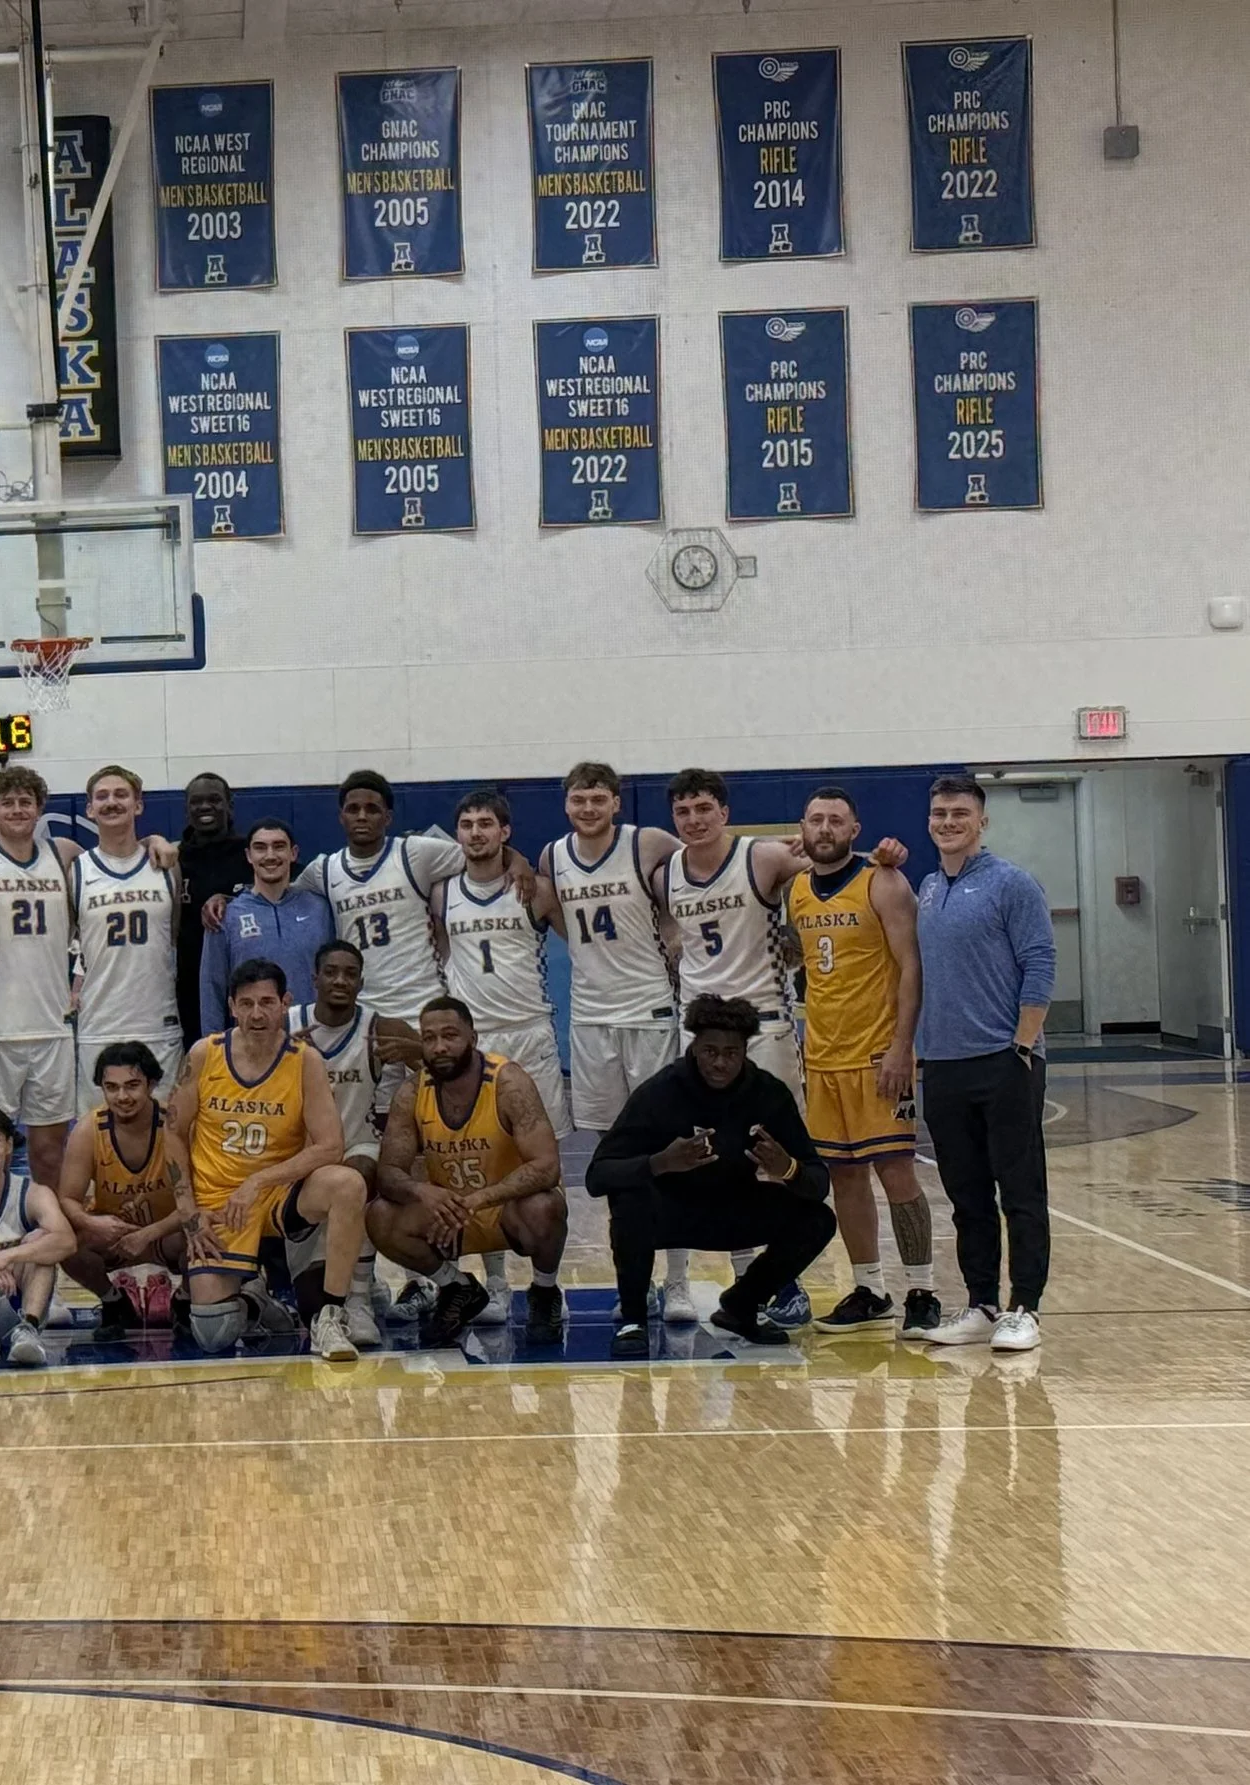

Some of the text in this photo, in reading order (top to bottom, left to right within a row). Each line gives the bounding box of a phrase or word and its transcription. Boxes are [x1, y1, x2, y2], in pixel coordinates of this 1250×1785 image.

[572, 101, 606, 120] GNAC
[764, 101, 791, 119] PRC
[954, 90, 981, 110] PRC
[381, 120, 418, 140] GNAC
[546, 120, 636, 142] TOURNAMENT
[738, 120, 819, 142] CHAMPIONS
[928, 110, 1010, 133] CHAMPIONS
[174, 132, 251, 154] NCAA WEST
[360, 141, 440, 162] CHAMPIONS
[554, 144, 629, 164] CHAMPIONS
[950, 136, 987, 166] RIFLE
[181, 155, 246, 175] REGIONAL
[760, 146, 798, 174] RIFLE
[347, 168, 455, 194] MEN'S BASKETBALL
[538, 171, 646, 198] MEN'S BASKETBALL
[941, 170, 998, 200] 2022
[160, 182, 267, 208] MEN'S BASKETBALL
[754, 180, 805, 210] 2014
[374, 198, 429, 227] 2005
[565, 200, 620, 230] 2022
[188, 212, 242, 241] 2003
[54, 130, 101, 441] ALASKA
[578, 356, 616, 375] NCAA
[770, 360, 798, 380] PRC
[960, 352, 988, 370] PRC
[201, 372, 237, 390] NCAA
[390, 366, 428, 384] NCAA
[546, 376, 651, 398] WEST REGIONAL
[934, 370, 1016, 394] CHAMPIONS
[168, 392, 272, 414] WEST REGIONAL
[358, 386, 462, 408] WEST REGIONAL
[744, 380, 826, 403] CHAMPIONS
[380, 407, 441, 428] SWEET 16
[568, 398, 630, 418] SWEET 16
[766, 406, 804, 433] RIFLE
[956, 396, 994, 425] RIFLE
[190, 414, 250, 434] SWEET 16
[358, 435, 464, 462] MEN'S BASKETBALL
[544, 424, 654, 452] MEN'S BASKETBALL
[947, 430, 1004, 460] 2025
[168, 441, 274, 468] MEN'S BASKETBALL
[760, 438, 813, 469] 2015
[384, 464, 440, 494] 2005
[572, 454, 628, 484] 2022
[194, 470, 248, 500] 2004
[88, 889, 164, 910] ALASKA
[336, 888, 406, 914] ALASKA
[560, 881, 630, 903] ALASKA
[12, 900, 48, 936] 21
[675, 894, 746, 919] ALASKA
[106, 910, 148, 947] 20
[354, 912, 391, 950] 13
[450, 917, 524, 936] ALASKA
[576, 905, 618, 944] 14
[800, 912, 860, 930] ALASKA
[700, 920, 724, 957] 5
[480, 940, 495, 974] 1
[817, 935, 836, 974] 3
[208, 1097, 286, 1116] ALASKA
[221, 1120, 268, 1156] 20
[424, 1137, 491, 1154] ALASKA
[442, 1158, 487, 1190] 35
